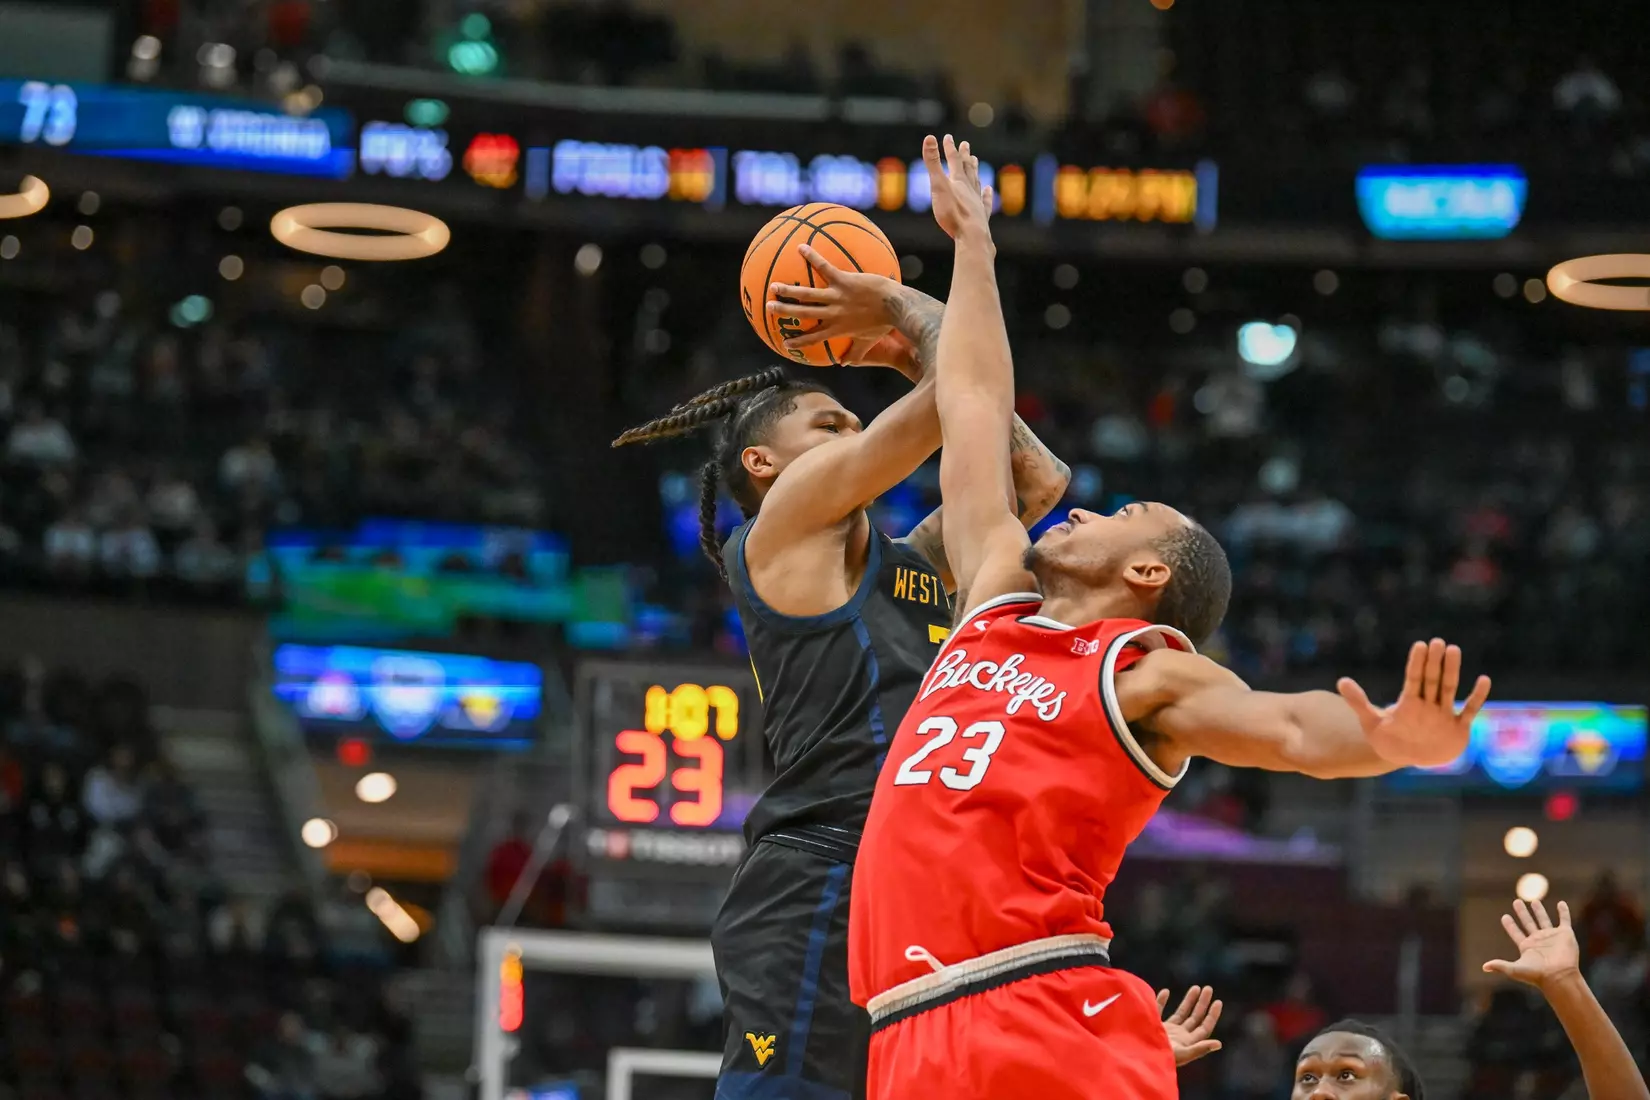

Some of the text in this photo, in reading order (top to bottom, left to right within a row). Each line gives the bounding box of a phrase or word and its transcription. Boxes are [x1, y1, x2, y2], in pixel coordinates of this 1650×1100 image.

[893, 567, 938, 606] WEST
[919, 649, 1067, 722] Buckeyes
[607, 730, 724, 826] 23
[894, 715, 1006, 791] 23
